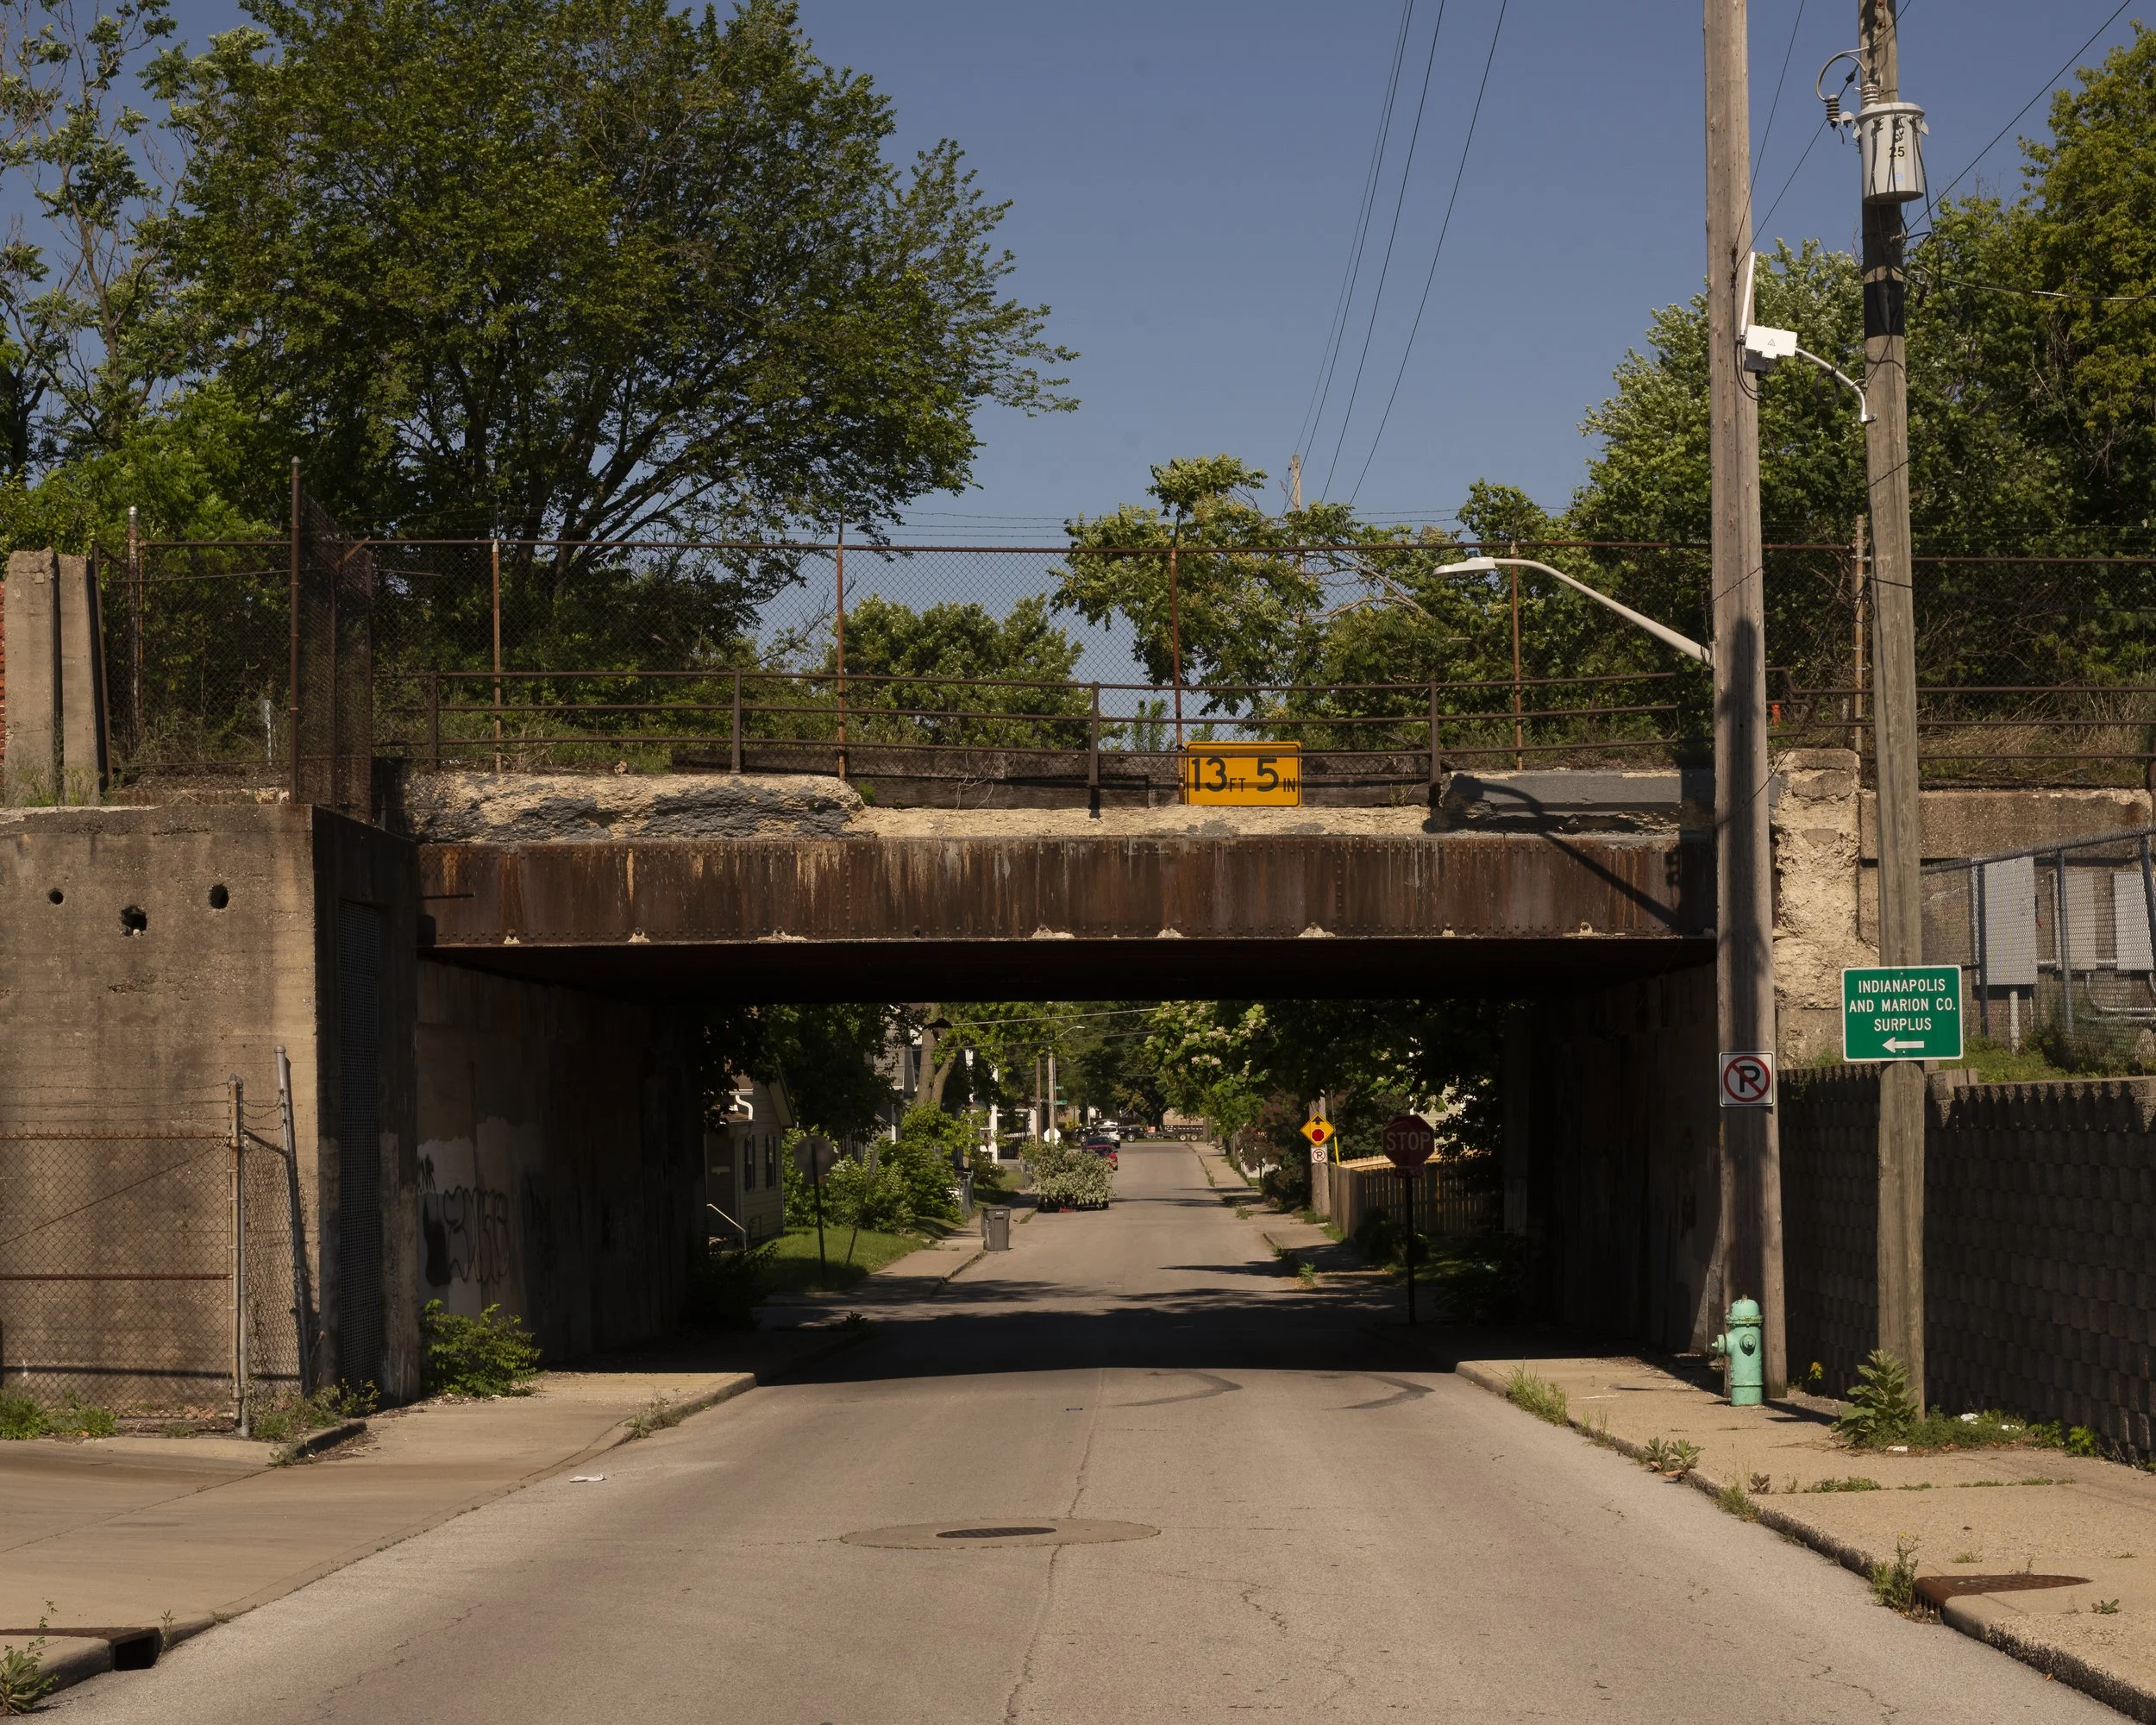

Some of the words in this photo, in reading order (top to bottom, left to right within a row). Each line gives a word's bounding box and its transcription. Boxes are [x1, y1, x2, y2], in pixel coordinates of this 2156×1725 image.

[1191, 756, 1227, 792] 13
[1229, 777, 1246, 792] FT
[1257, 757, 1279, 792] 5
[1282, 777, 1296, 792] IN
[1858, 979, 1946, 993] INDIANAPOLIS
[1848, 999, 1875, 1013] AND
[1881, 998, 1929, 1012] MARION
[1936, 998, 1956, 1011] CO.
[1874, 1018, 1932, 1032] SURPLUS
[1739, 1065, 1760, 1093] P
[1386, 1132, 1431, 1151] STOP
